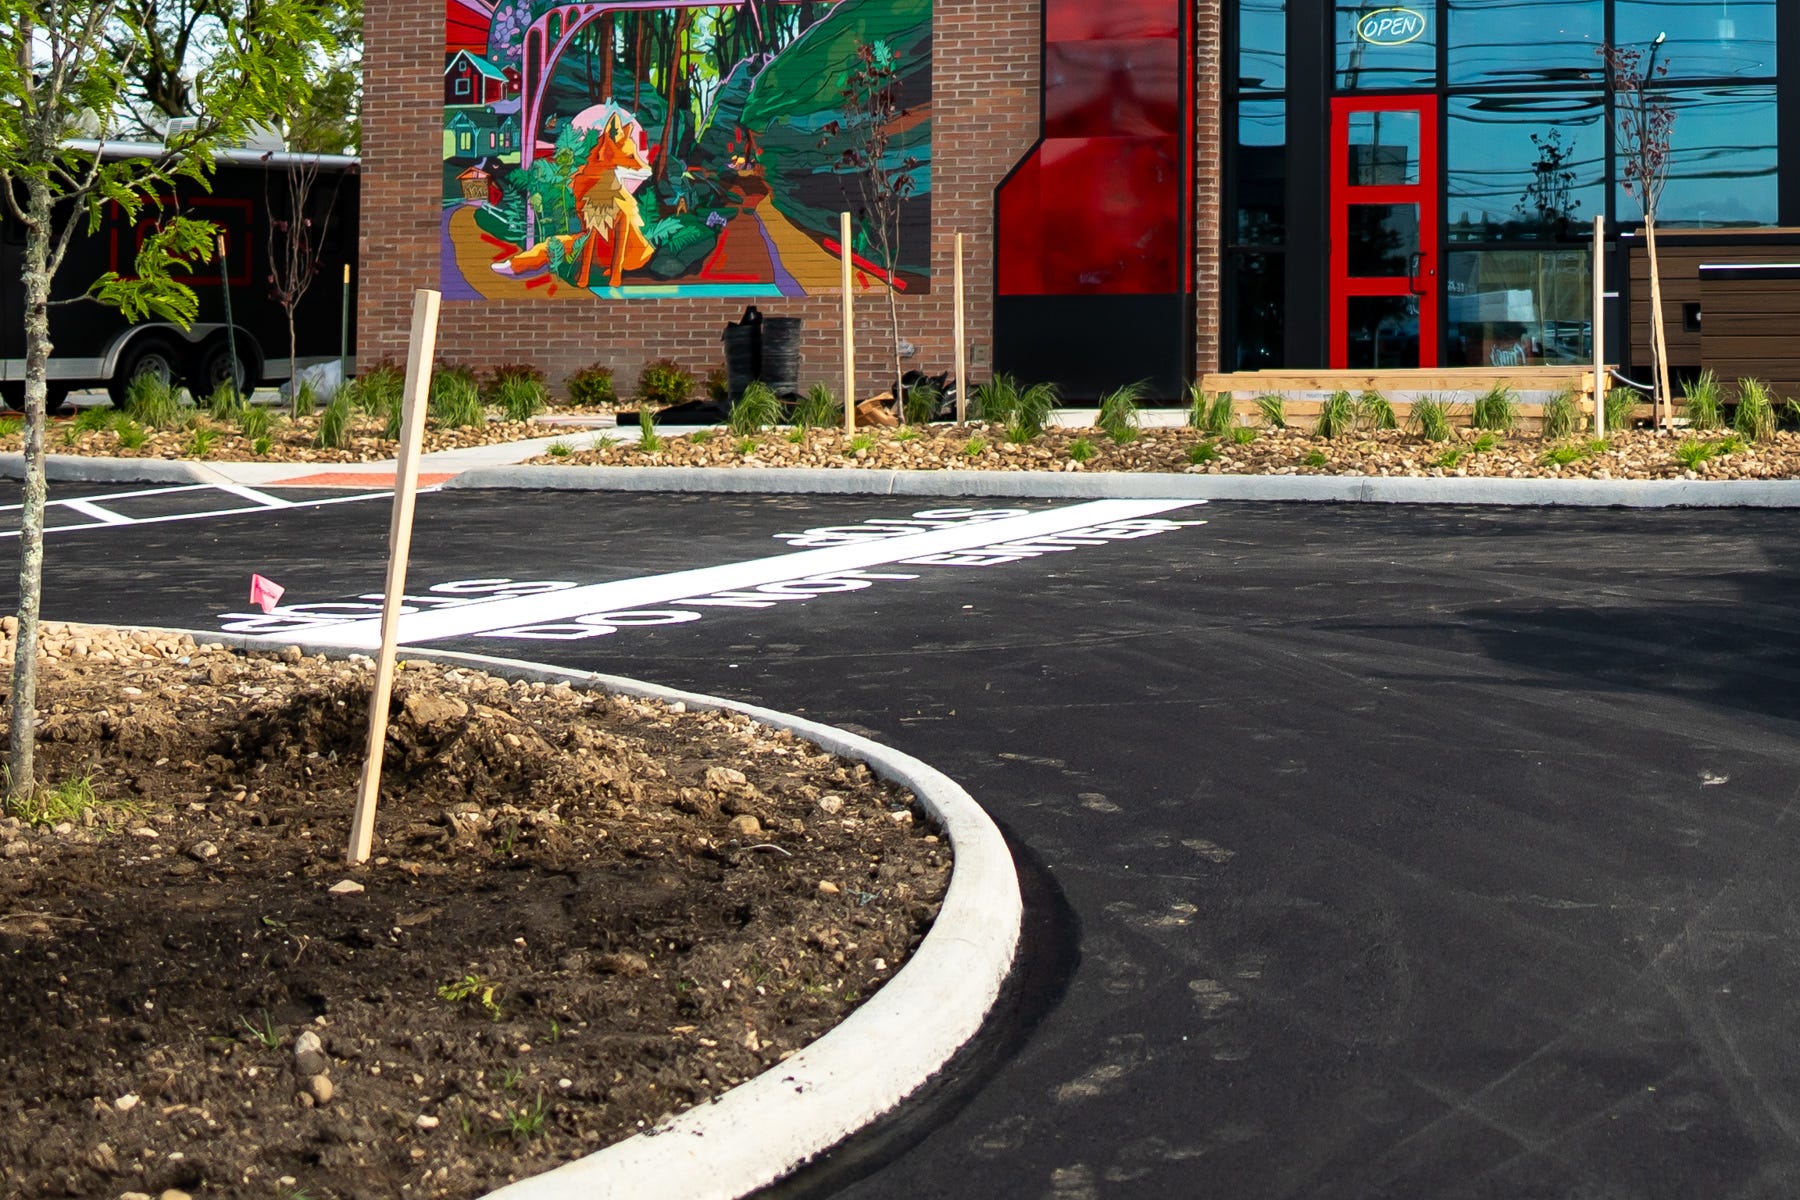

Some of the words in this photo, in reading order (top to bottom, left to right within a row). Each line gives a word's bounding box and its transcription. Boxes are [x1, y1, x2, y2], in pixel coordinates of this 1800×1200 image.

[1363, 17, 1417, 37] OPEN
[474, 610, 702, 640] DO
[669, 569, 920, 608] NOT
[899, 519, 1208, 567] ENTER
